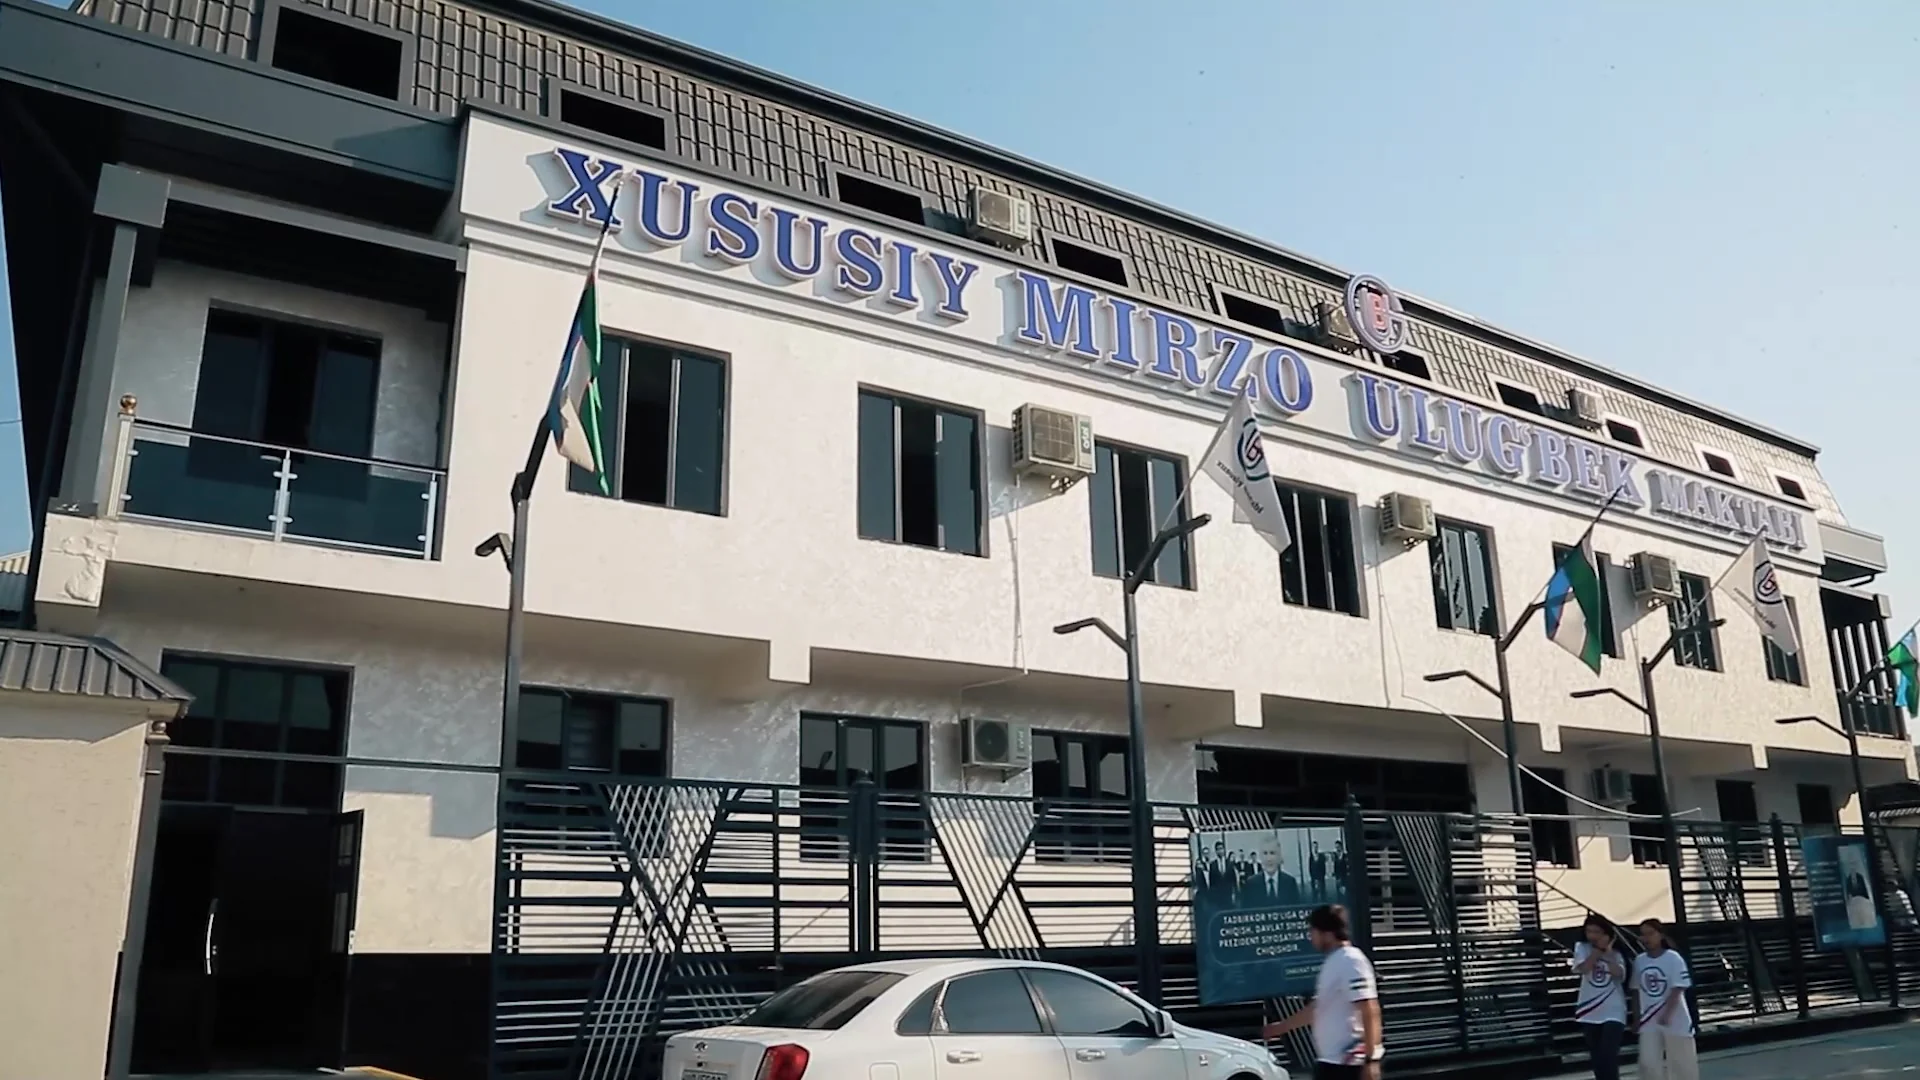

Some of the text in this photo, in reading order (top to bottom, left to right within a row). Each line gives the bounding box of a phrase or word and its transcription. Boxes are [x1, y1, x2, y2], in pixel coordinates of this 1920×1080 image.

[547, 147, 979, 321] XUSUSIY
[1014, 269, 1314, 417] MIRZO
[1652, 470, 1807, 549] MAKTABI
[1255, 922, 1284, 933] DAVLAT
[1219, 935, 1260, 947] PREZIDENT
